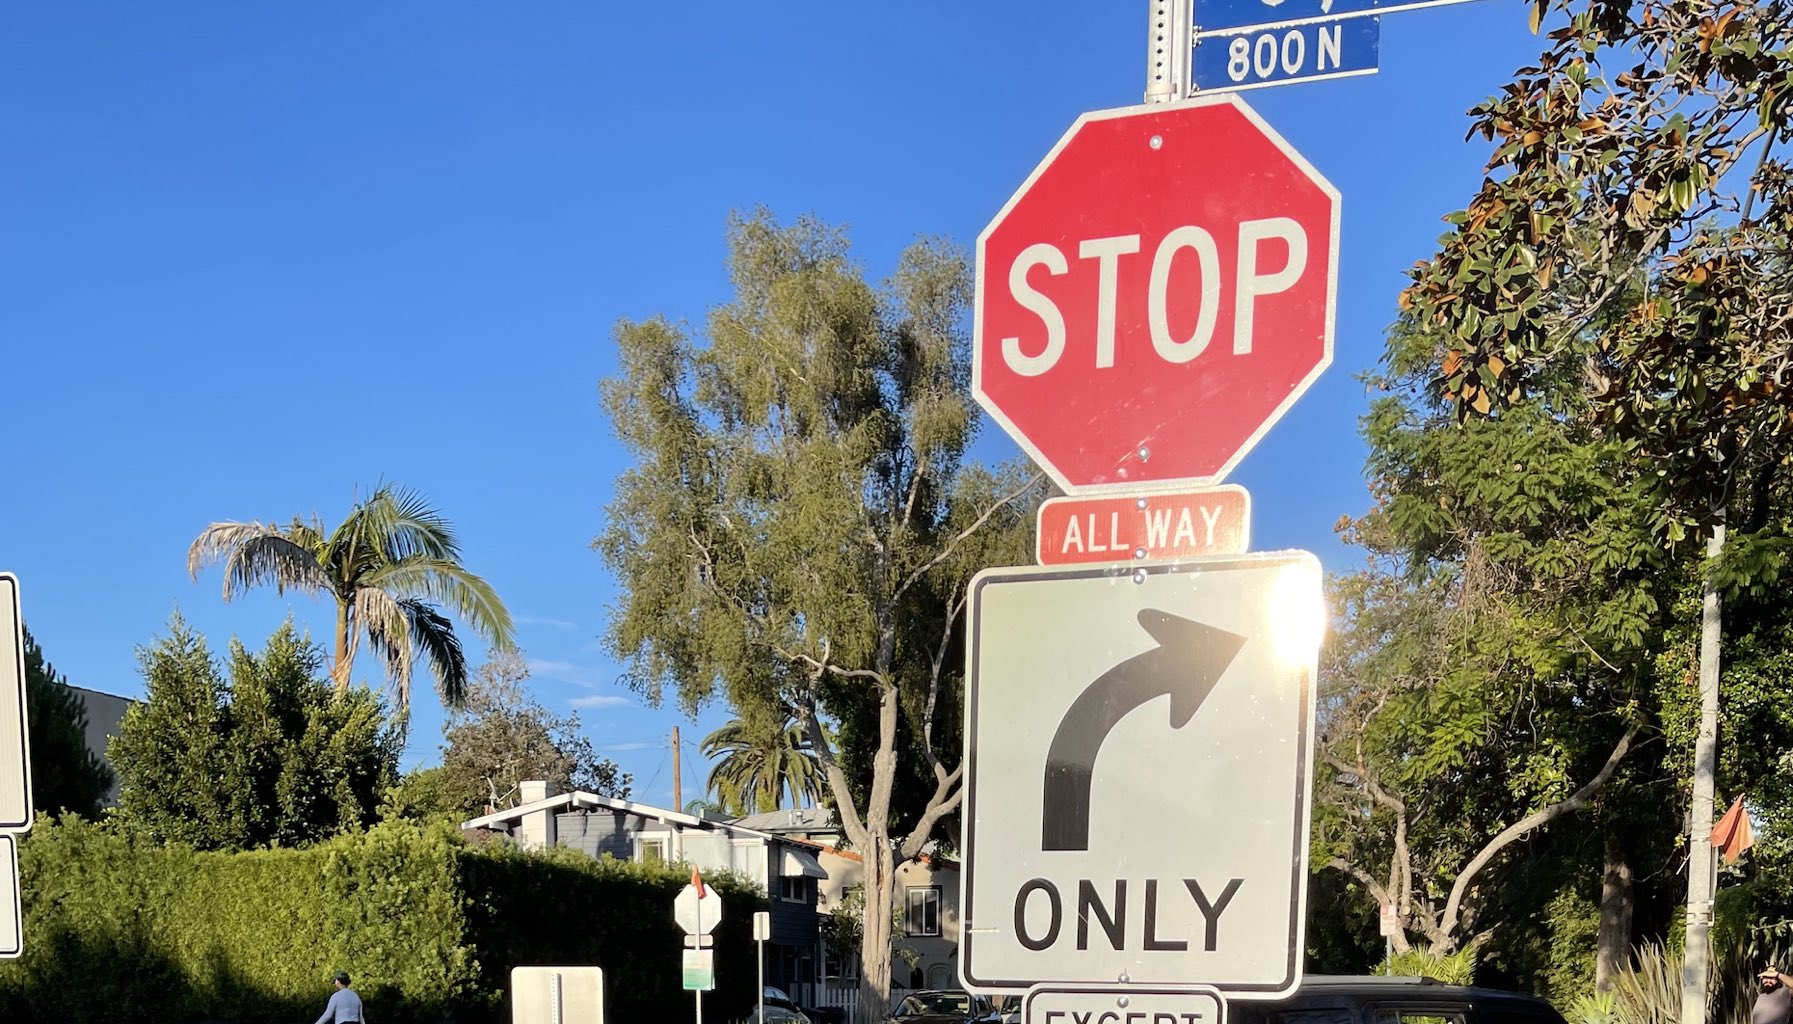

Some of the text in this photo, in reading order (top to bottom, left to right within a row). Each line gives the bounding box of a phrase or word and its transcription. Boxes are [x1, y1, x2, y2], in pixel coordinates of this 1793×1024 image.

[1227, 25, 1342, 82] 800 N
[1001, 217, 1308, 377] STOP
[1061, 505, 1223, 553] ALL WAY
[1014, 878, 1245, 951] ONLY
